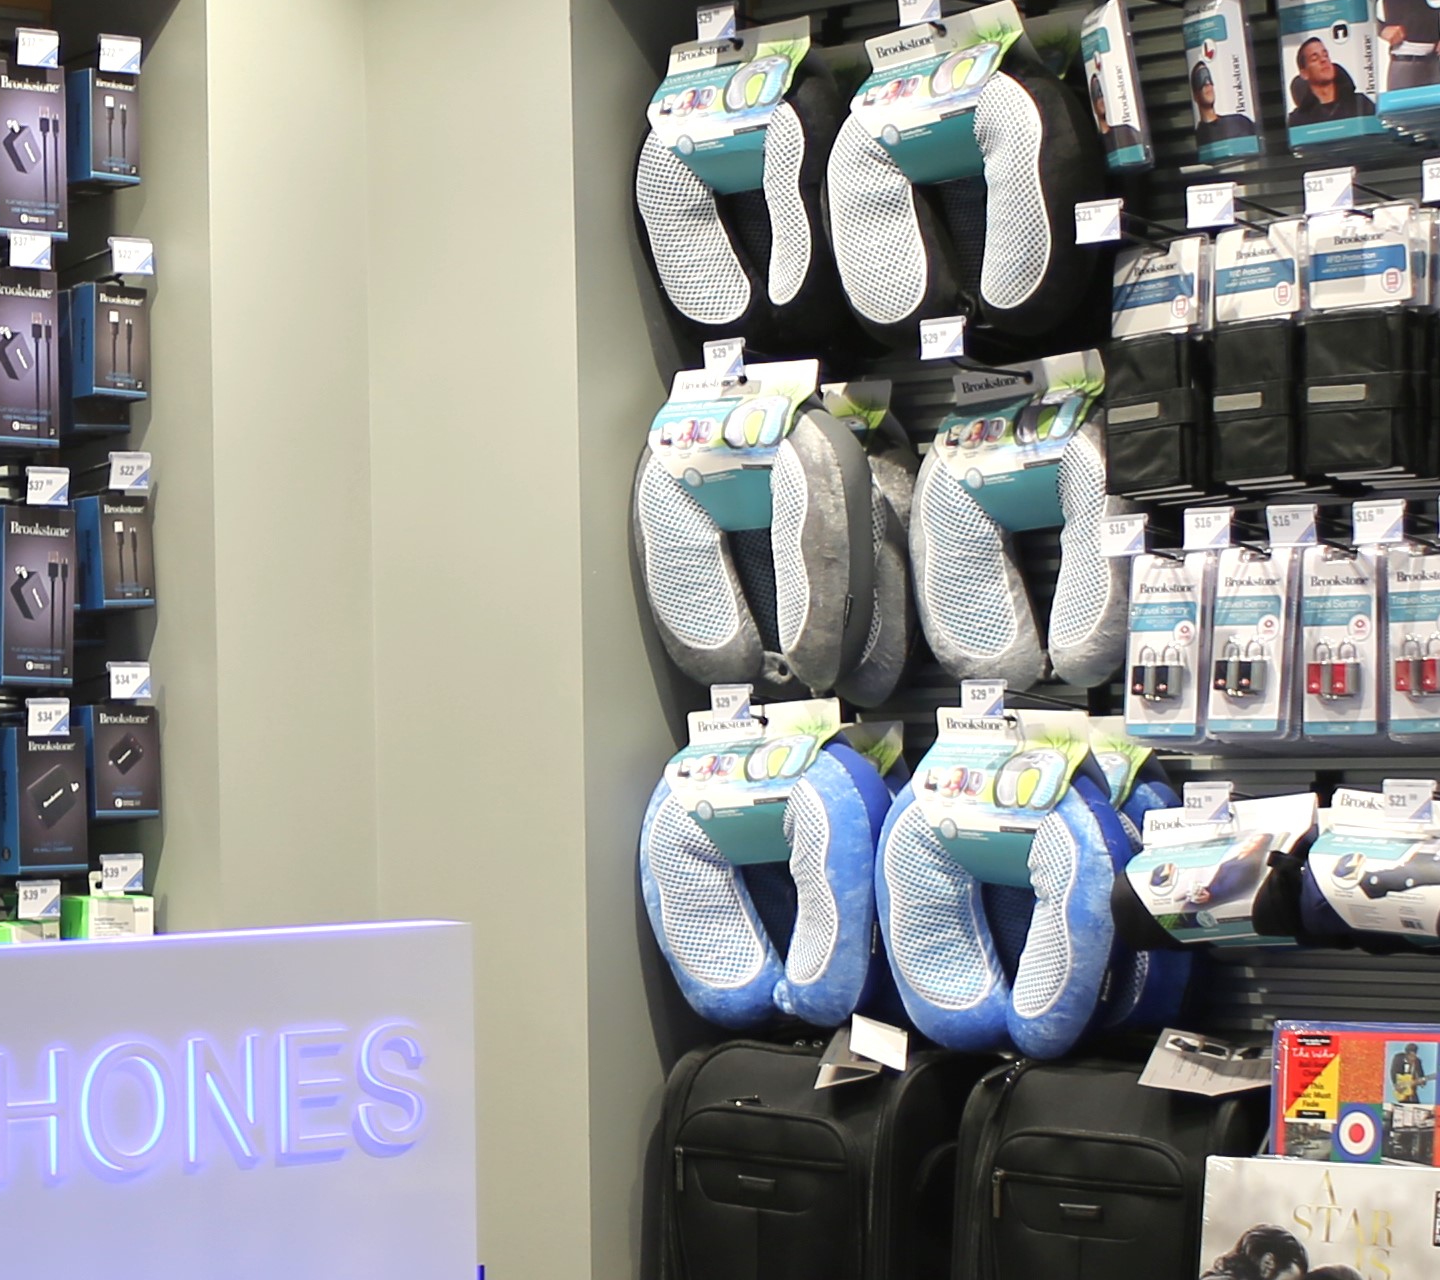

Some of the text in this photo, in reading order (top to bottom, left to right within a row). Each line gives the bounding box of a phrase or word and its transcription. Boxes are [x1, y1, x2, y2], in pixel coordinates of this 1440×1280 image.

[875, 34, 934, 59] Brookstone
[1, 75, 61, 93] Brookstone
[1224, 576, 1281, 588] Brookstone
[1310, 575, 1368, 587] Brookstone
[1140, 583, 1195, 595] Brookstone
[1292, 1203, 1395, 1248] STAR
